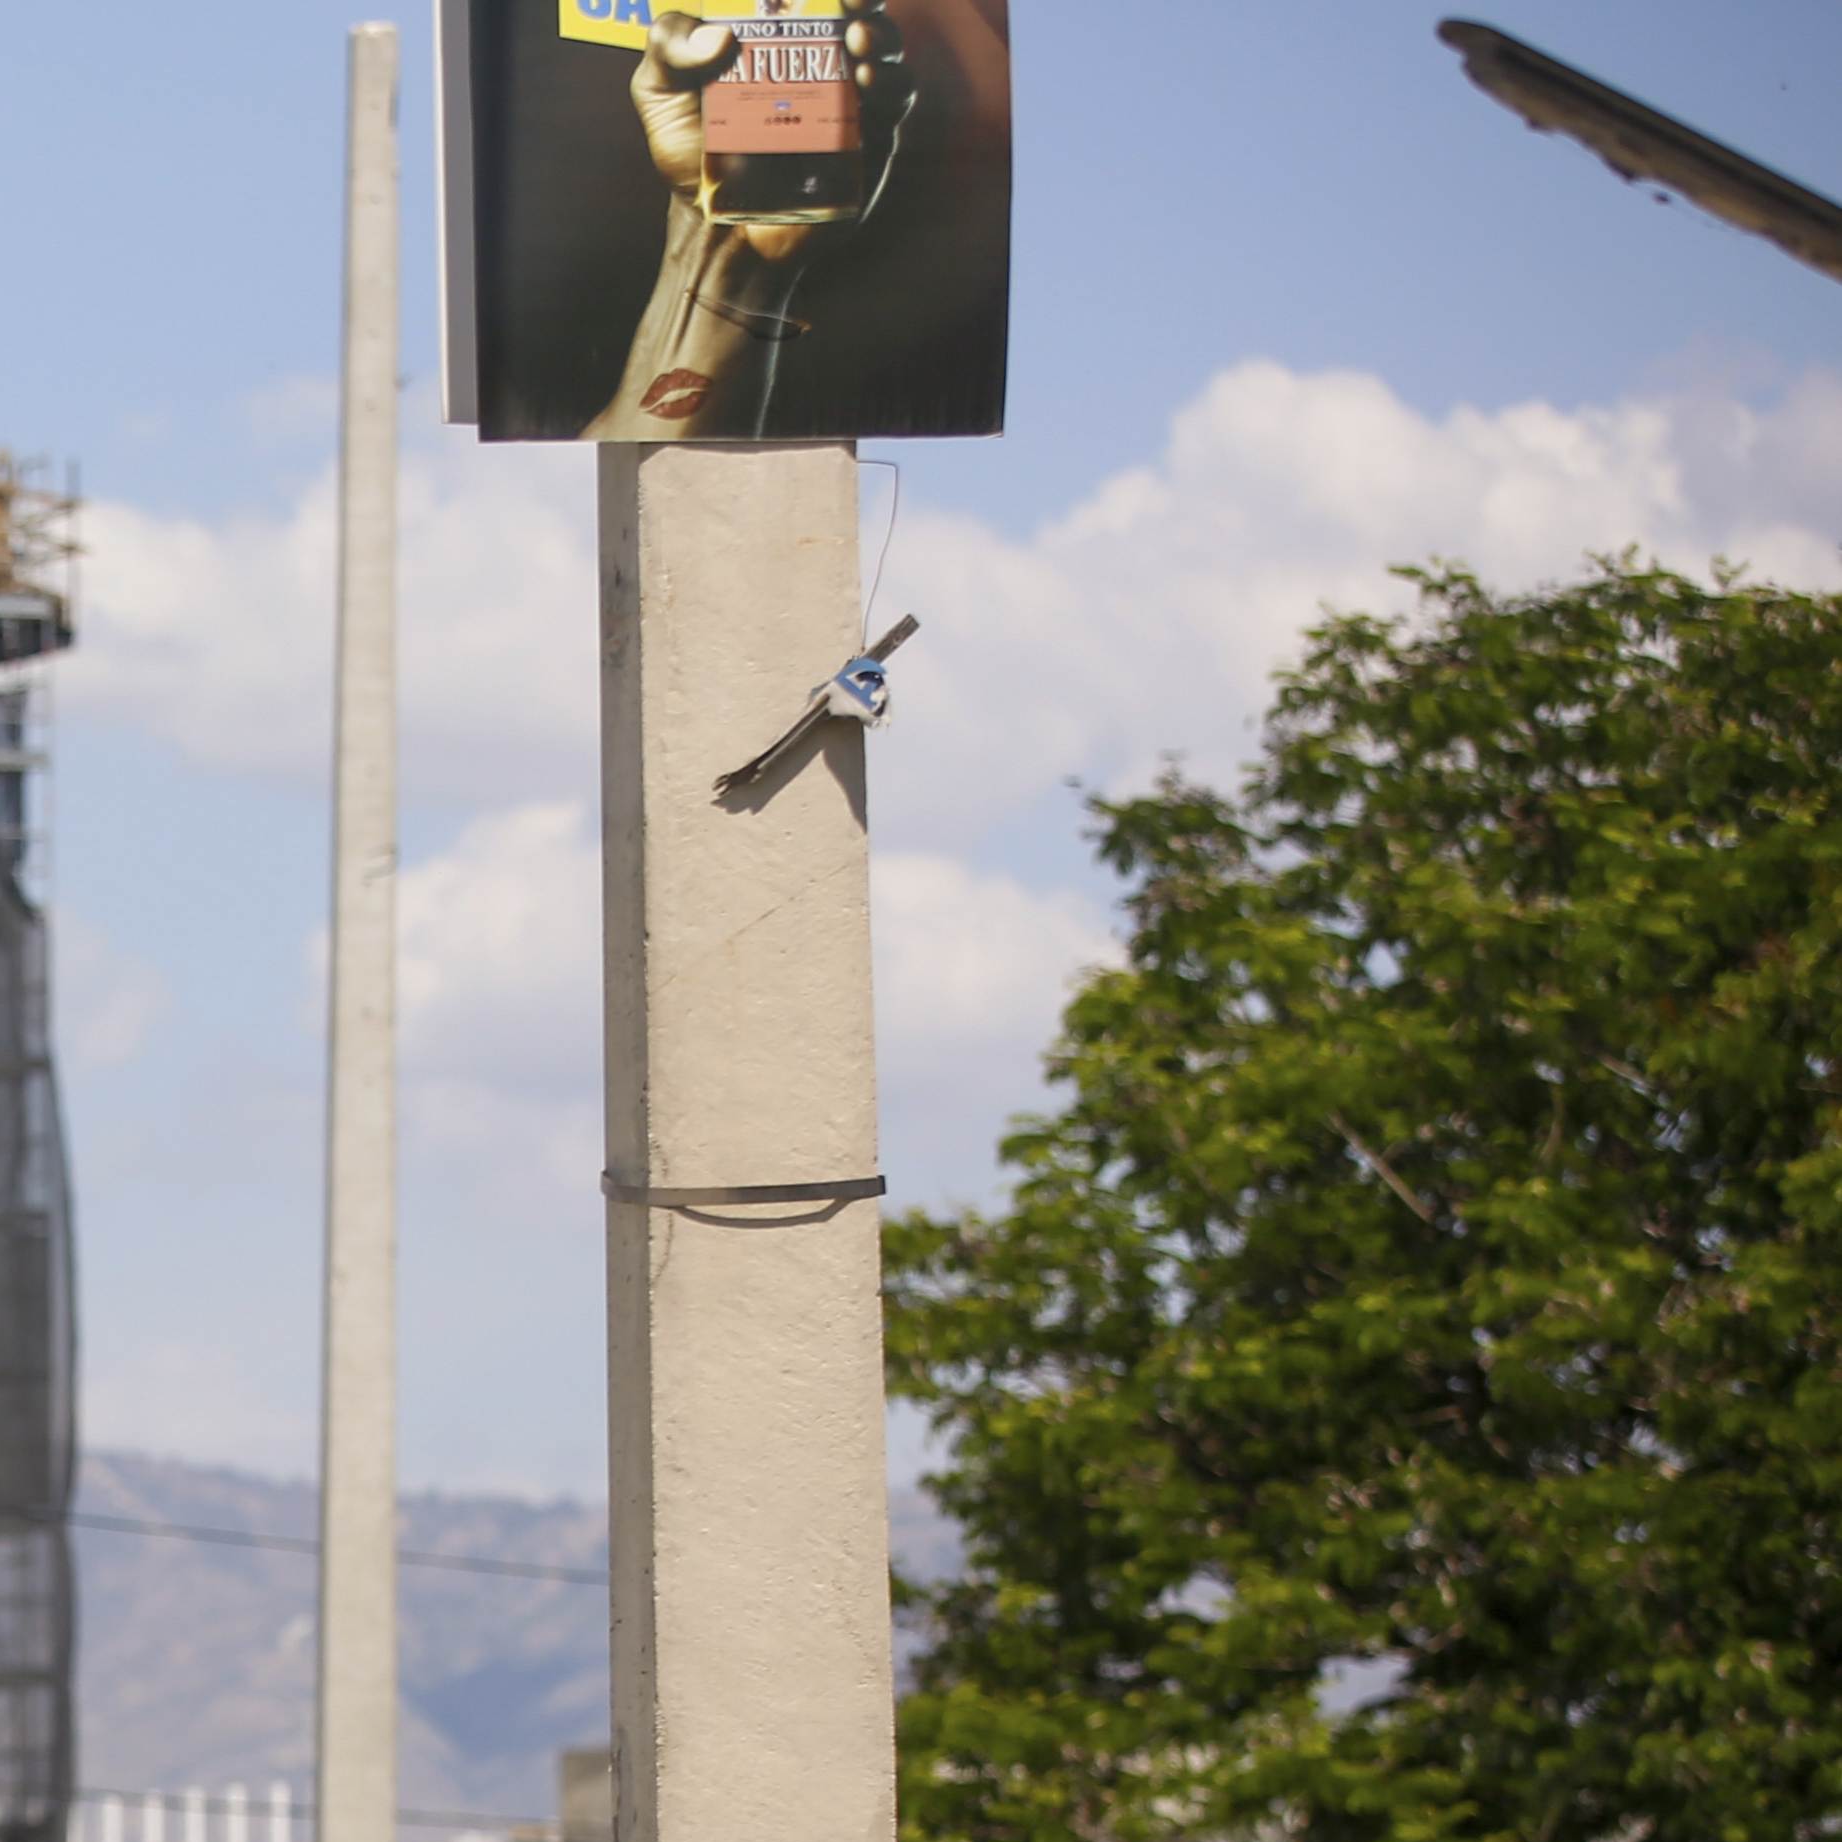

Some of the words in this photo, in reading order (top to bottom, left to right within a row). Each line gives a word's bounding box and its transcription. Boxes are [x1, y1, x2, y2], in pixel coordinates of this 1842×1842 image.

[731, 22, 777, 38] VINO
[779, 21, 834, 37] TINTO
[751, 46, 848, 83] FUERZA
